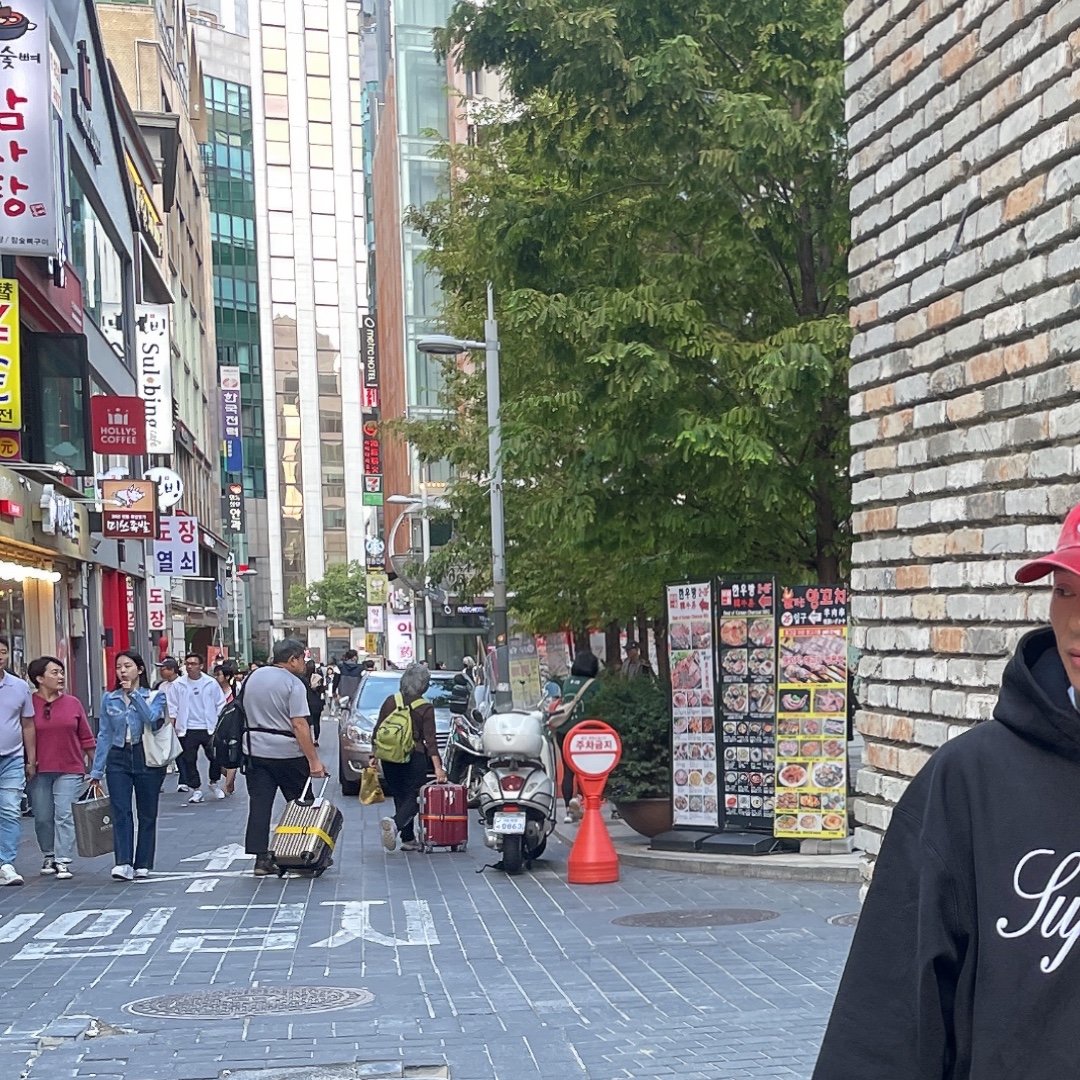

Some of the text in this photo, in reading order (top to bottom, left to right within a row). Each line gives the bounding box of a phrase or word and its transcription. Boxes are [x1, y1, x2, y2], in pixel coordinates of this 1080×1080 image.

[367, 356, 376, 381] HOTEL
[101, 426, 137, 436] HOLLYS
[101, 435, 137, 445] COFFEE
[1, 440, 13, 455] 元
[158, 520, 195, 544] 도장
[156, 550, 197, 574] 열쇠
[806, 587, 847, 610] 양꼬치
[148, 588, 165, 629] 도장
[793, 611, 807, 625] 입구
[575, 740, 613, 750] 주차금지
